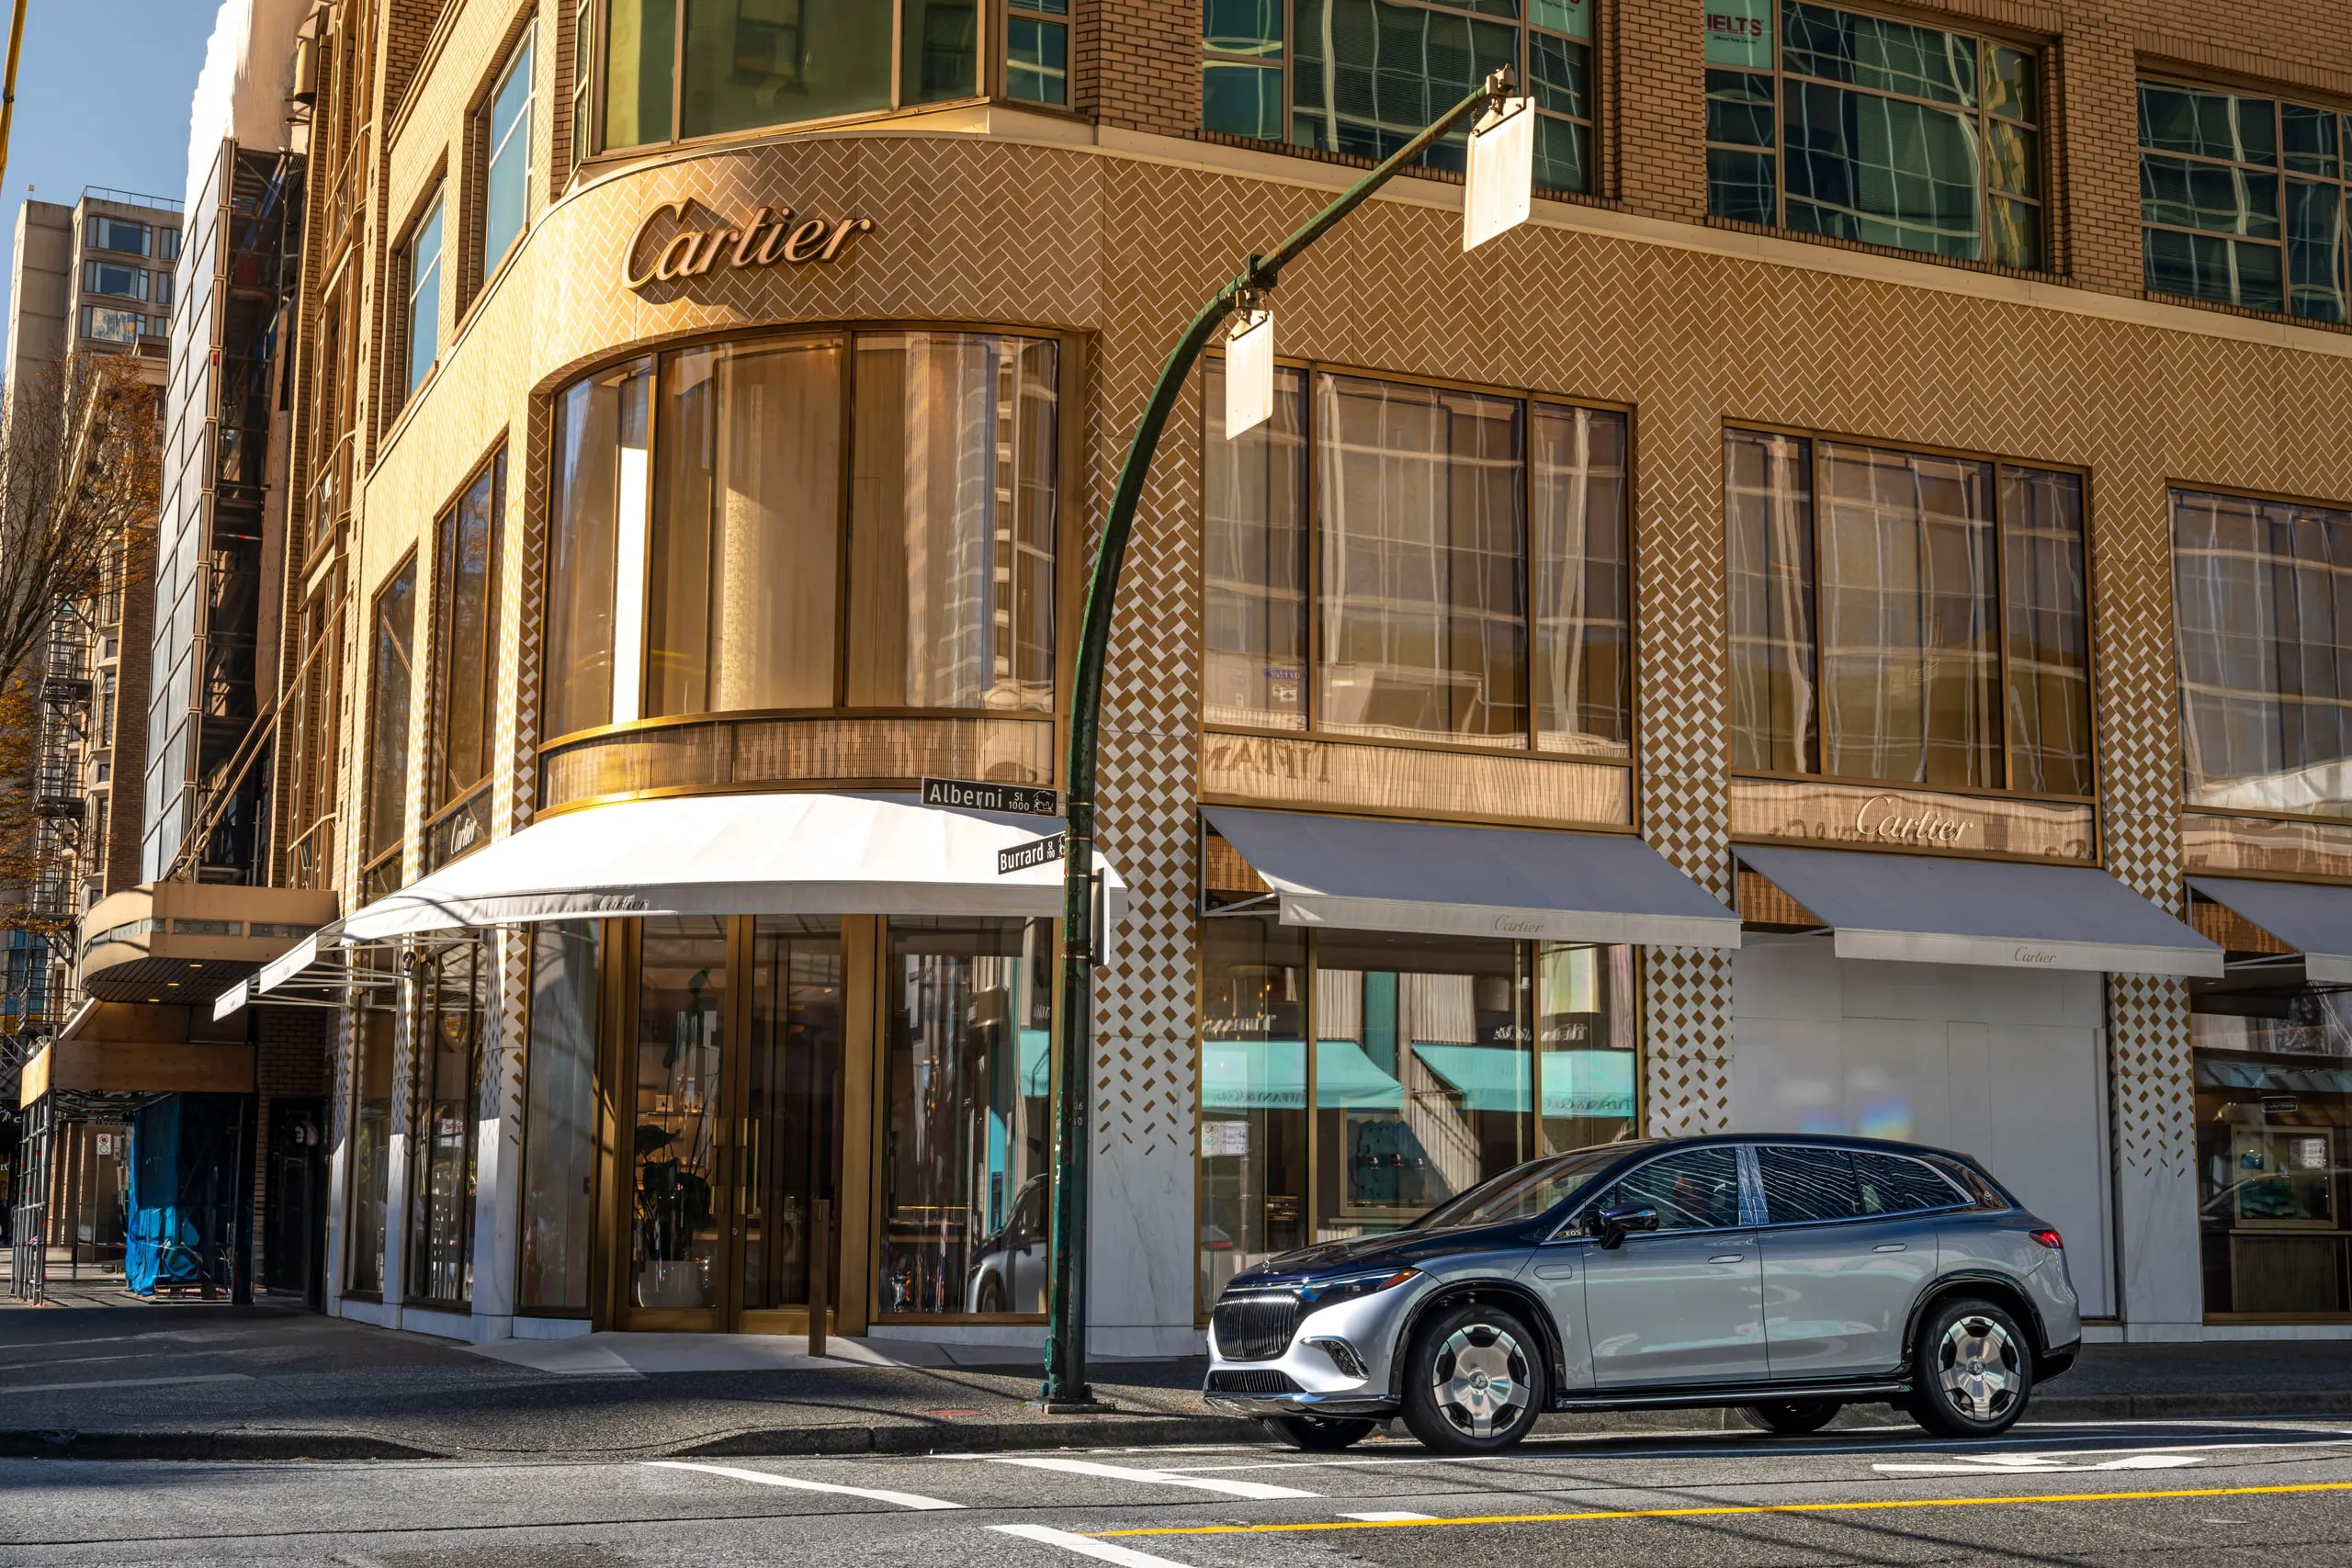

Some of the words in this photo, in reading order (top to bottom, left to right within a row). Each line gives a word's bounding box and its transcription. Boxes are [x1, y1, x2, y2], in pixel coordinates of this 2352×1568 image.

[1706, 14, 1763, 37] IELTS
[621, 197, 876, 291] Cartier
[929, 783, 1002, 808] Alberni
[1013, 791, 1023, 802] St
[1008, 800, 1030, 811] 1000
[1857, 795, 1973, 841] Cartier
[450, 814, 478, 854] Cartier
[1000, 841, 1044, 871] Burrard
[1047, 840, 1053, 851] St
[1046, 850, 1056, 860] 700
[598, 894, 650, 910] Cartier
[1494, 914, 1544, 932] Cartier
[2014, 946, 2057, 964] Cartier
